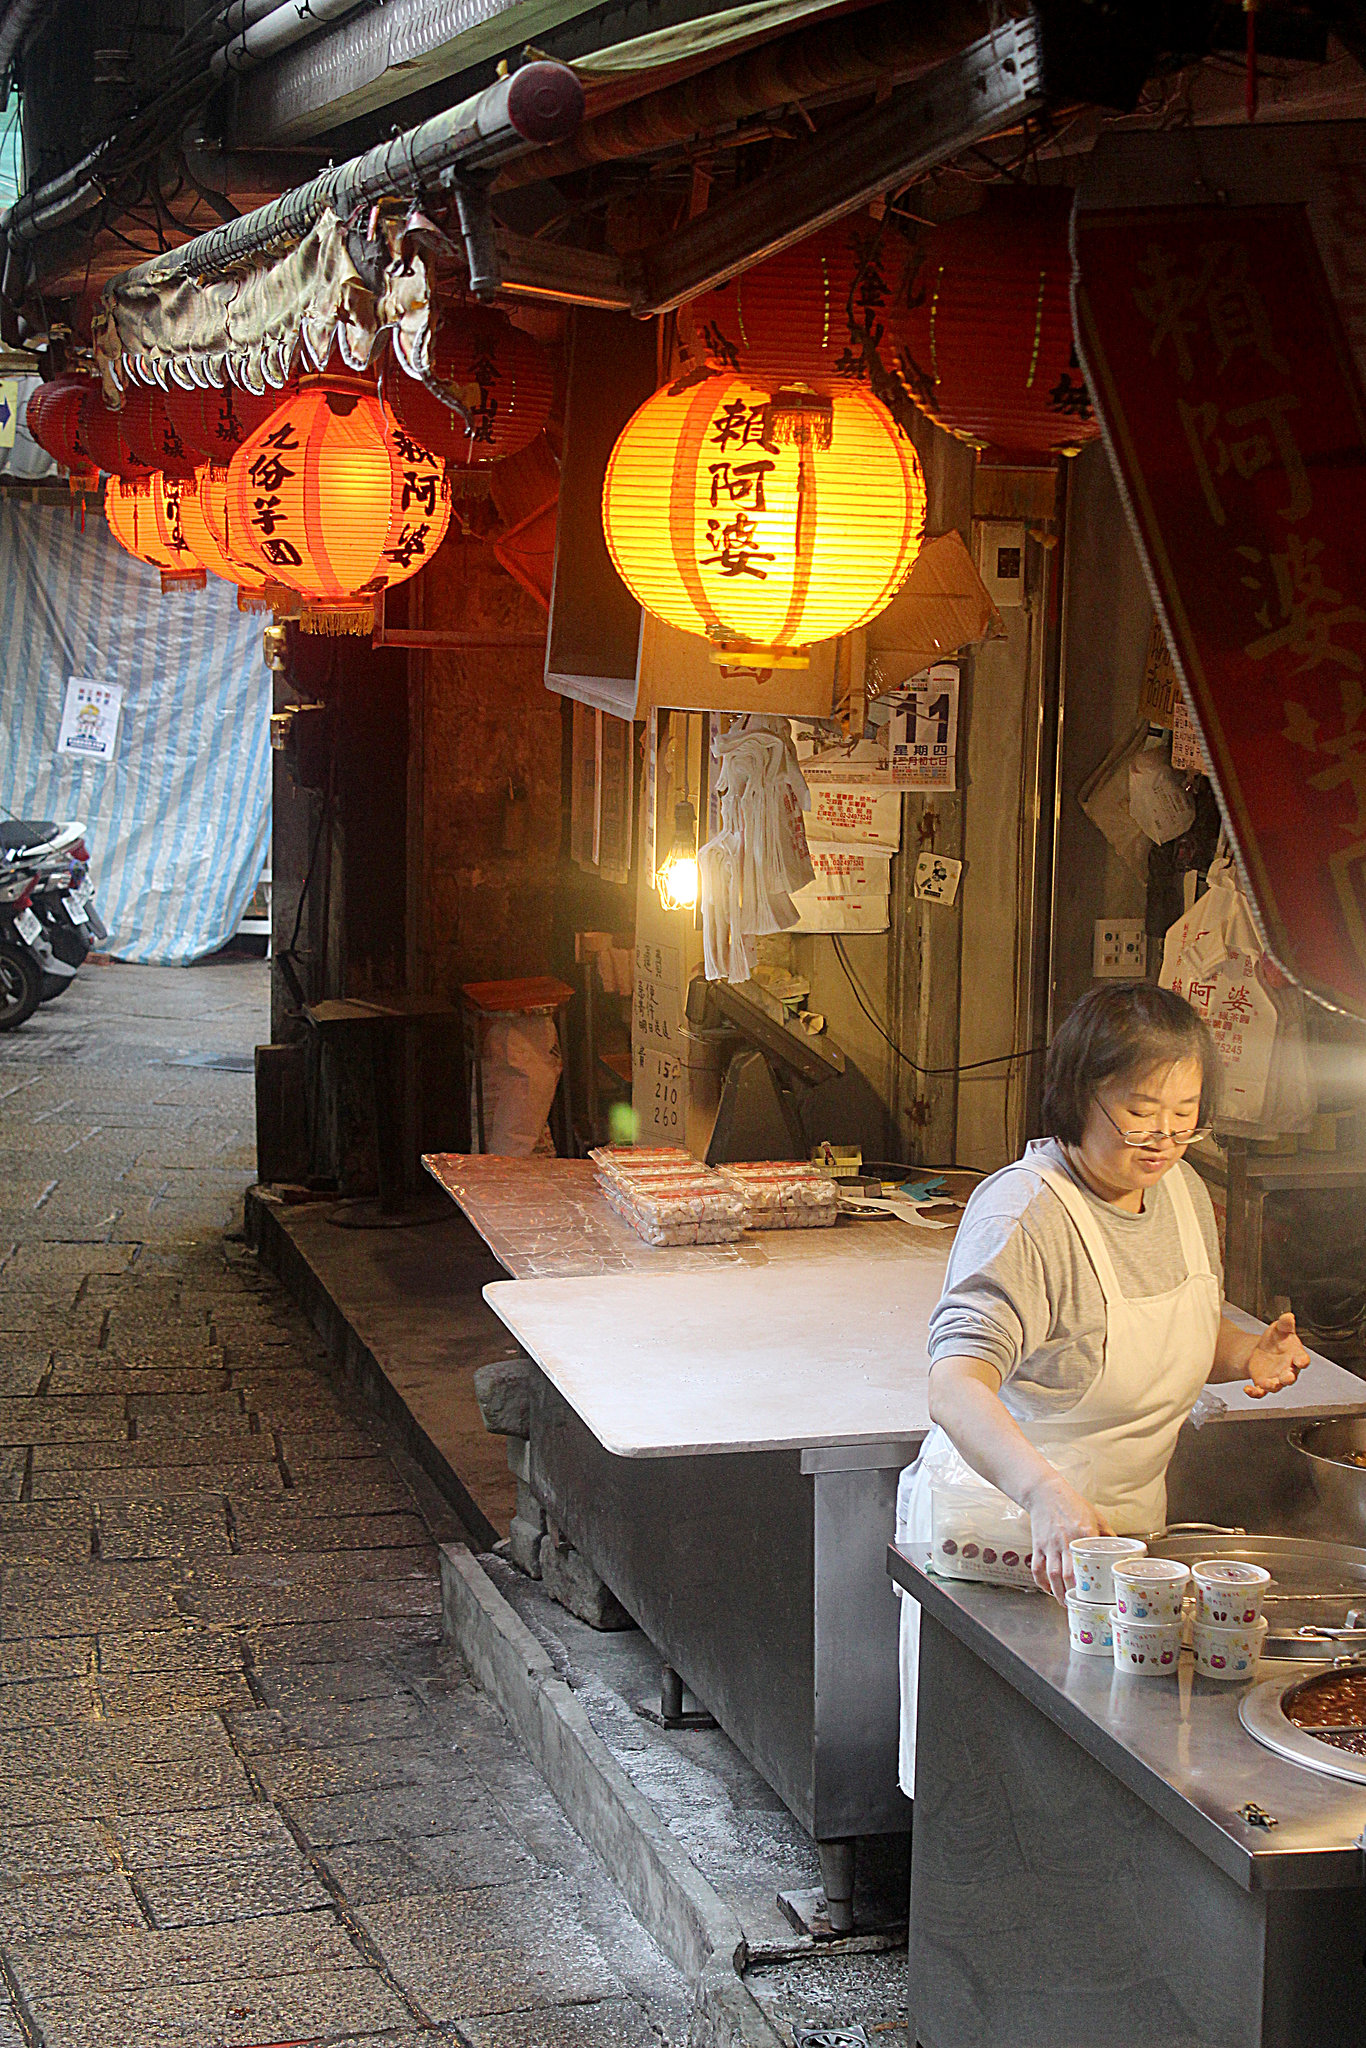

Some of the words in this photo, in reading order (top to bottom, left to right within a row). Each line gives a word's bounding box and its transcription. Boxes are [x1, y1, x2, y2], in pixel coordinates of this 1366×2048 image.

[247, 422, 302, 567] 九份芋圓
[701, 397, 780, 580] 賴阿婆
[896, 693, 950, 743] 11
[893, 744, 948, 756] 星期四
[655, 1082, 677, 1104] 210
[654, 1106, 677, 1127] 260
